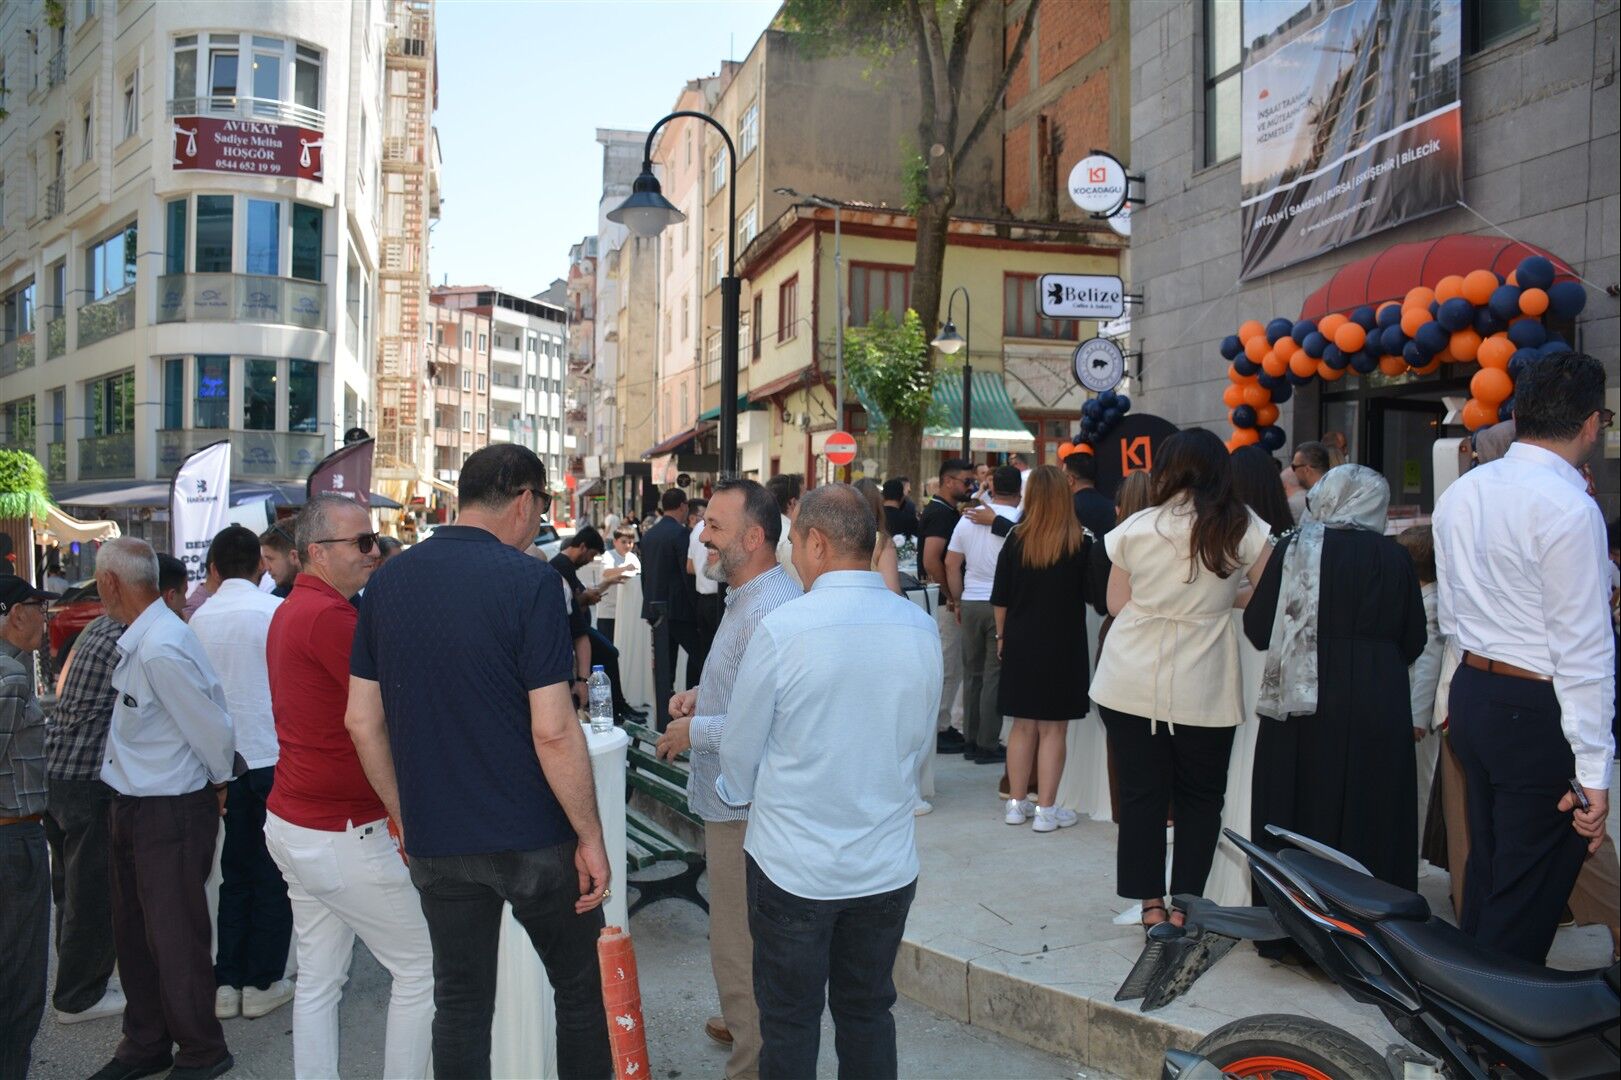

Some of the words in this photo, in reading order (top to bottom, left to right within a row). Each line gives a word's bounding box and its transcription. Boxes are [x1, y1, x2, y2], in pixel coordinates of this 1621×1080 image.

[223, 120, 278, 135] AVUKAT
[214, 132, 248, 146] Şadiye
[251, 136, 283, 149] Melisa
[223, 146, 275, 160] HOŞGÖR
[215, 158, 237, 169] 0544
[239, 161, 256, 171] 652
[258, 163, 268, 172] 19
[270, 163, 281, 173] 99
[1289, 194, 1322, 216] SAMSUN
[1326, 180, 1351, 200] BURSA
[1401, 139, 1441, 165] BİLECİK
[1065, 286, 1120, 303] Belize
